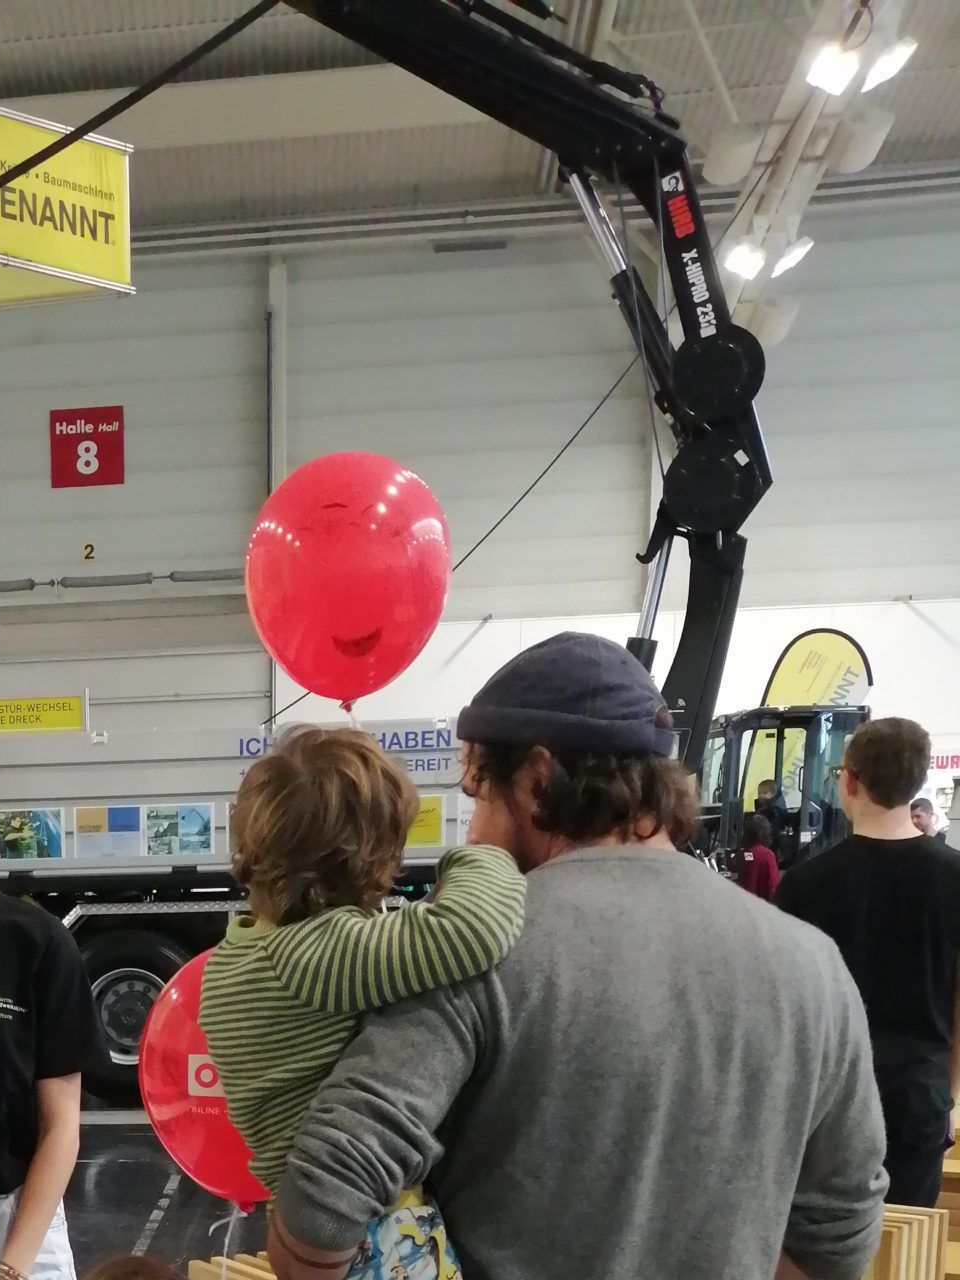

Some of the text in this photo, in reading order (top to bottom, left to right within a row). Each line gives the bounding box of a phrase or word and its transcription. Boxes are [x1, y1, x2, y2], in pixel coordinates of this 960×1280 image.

[42, 171, 116, 203] Baumaschinen
[681, 248, 710, 304] X-HIPRO
[55, 419, 119, 435] Halle Hall
[76, 440, 100, 475] 8
[84, 543, 95, 560] 2
[9, 714, 42, 725] DRECK
[407, 757, 452, 772] EREIT
